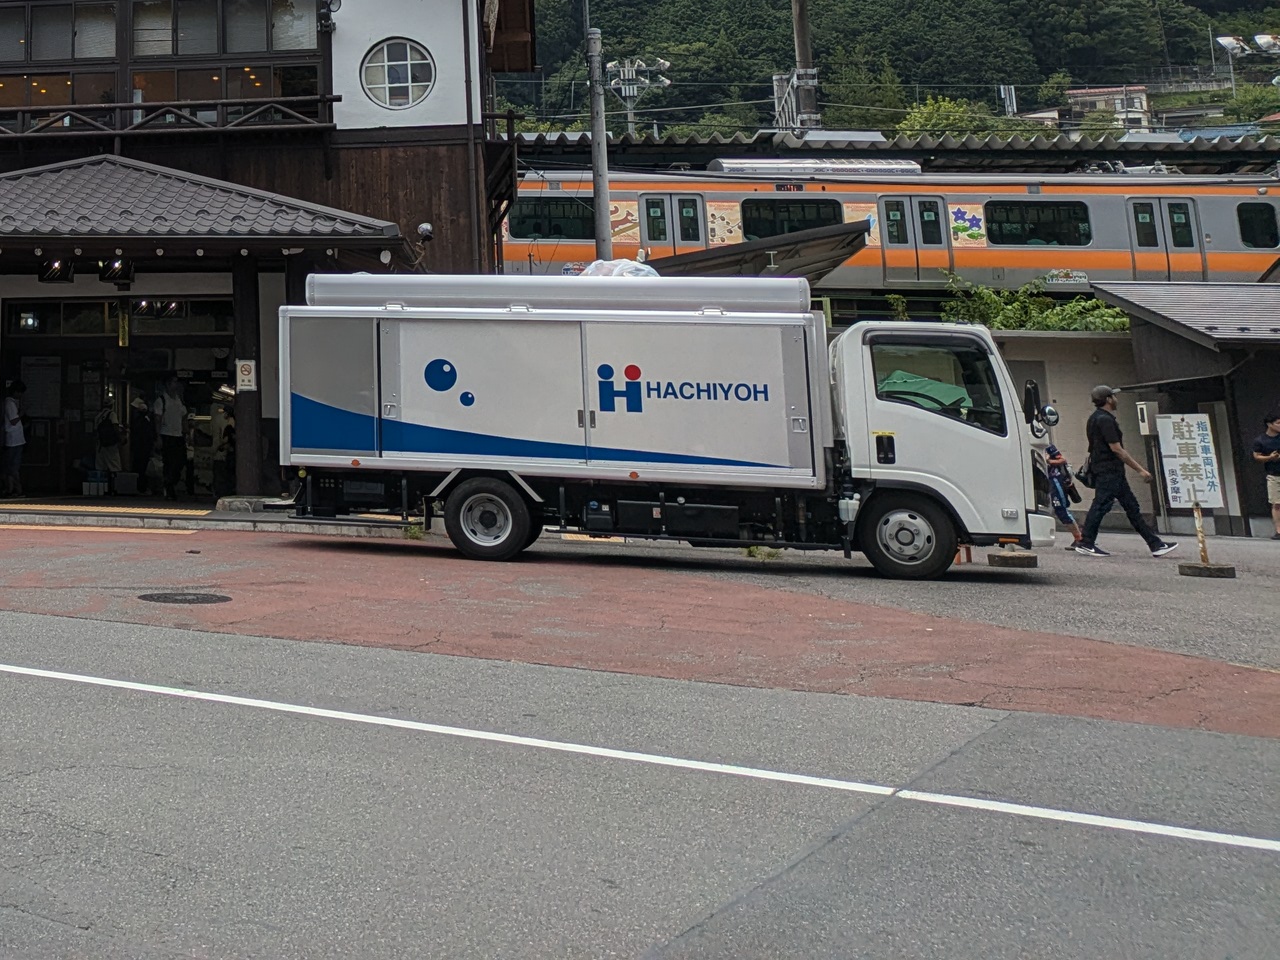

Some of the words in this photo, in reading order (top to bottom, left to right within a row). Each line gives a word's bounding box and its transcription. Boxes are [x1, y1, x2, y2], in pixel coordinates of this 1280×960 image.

[646, 381, 770, 401] HACHIYOH
[1171, 421, 1208, 503] 駐車禁止
[1196, 420, 1220, 493] 指定車両以外
[1168, 468, 1182, 503] 奥多摩町
